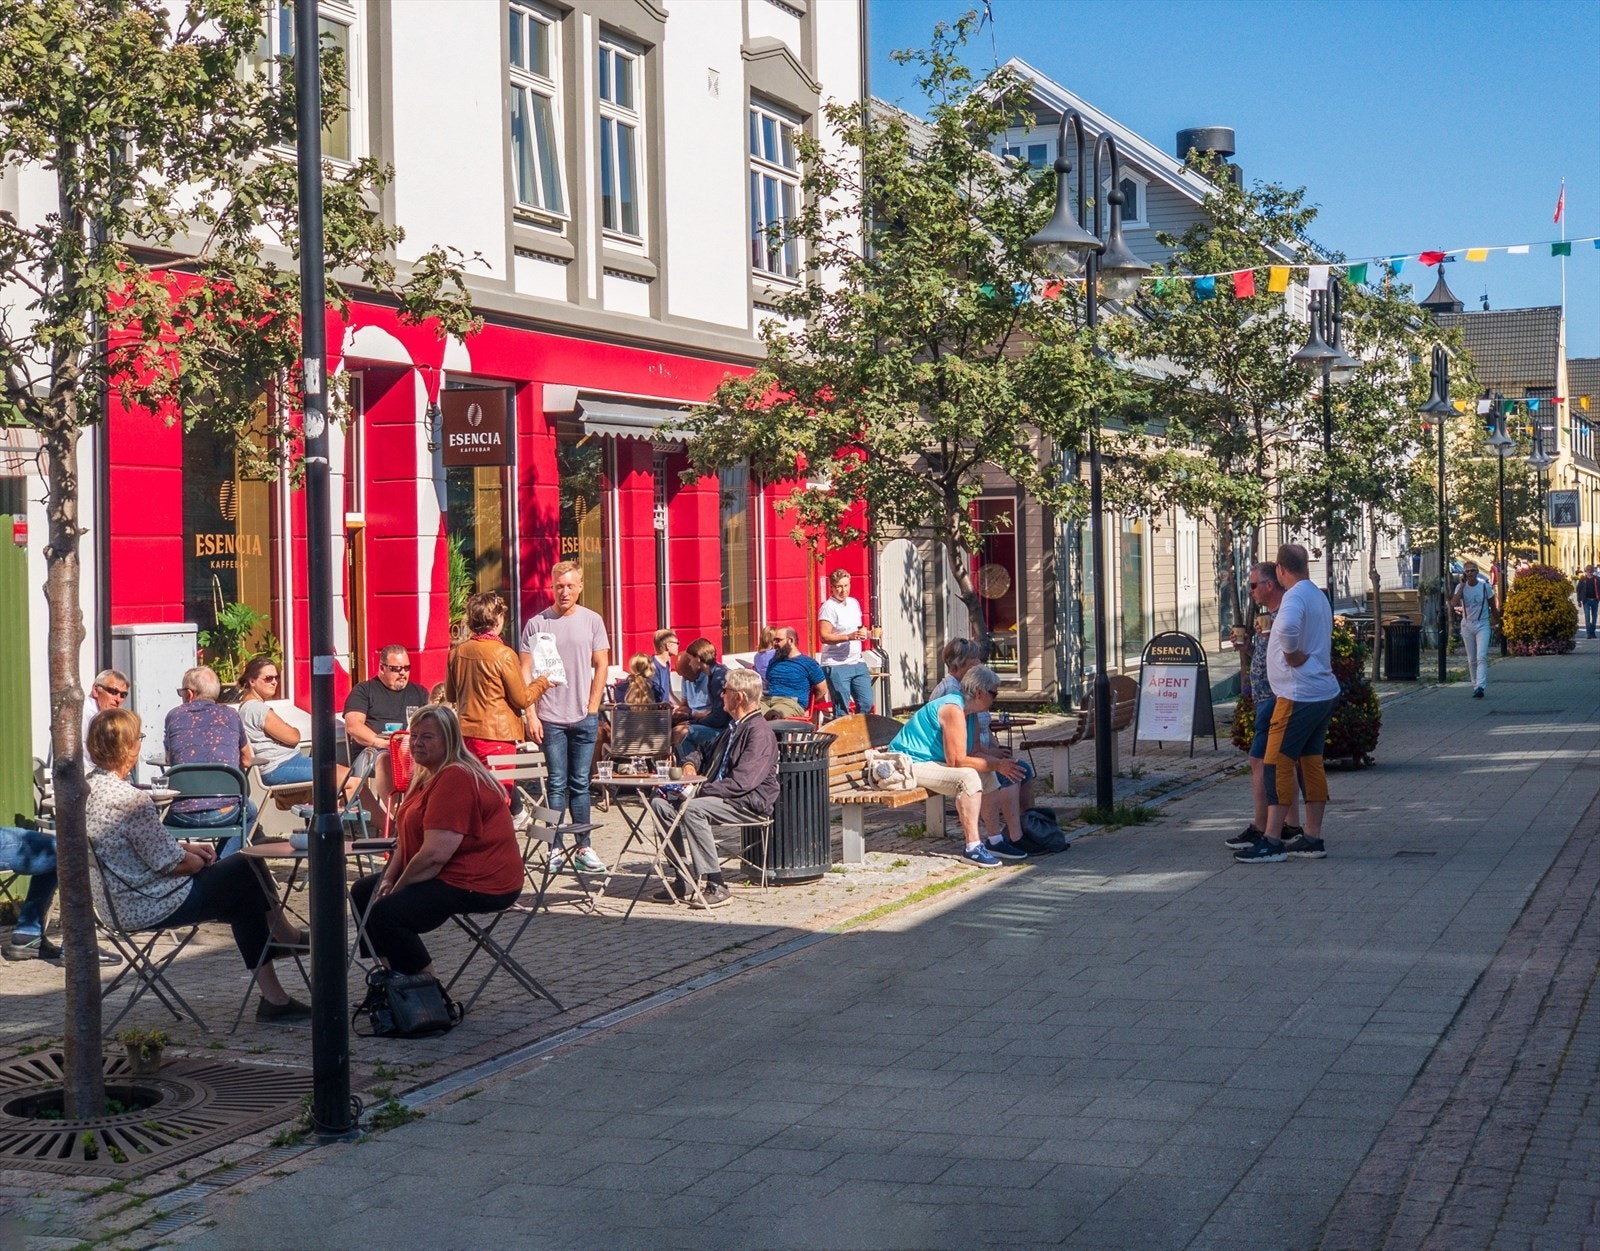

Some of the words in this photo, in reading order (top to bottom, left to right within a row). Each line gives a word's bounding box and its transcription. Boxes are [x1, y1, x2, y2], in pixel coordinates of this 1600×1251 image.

[449, 432, 502, 447] ESENCIA
[195, 533, 263, 557] ESENCIA
[561, 536, 602, 555] ESENCIA
[210, 560, 249, 569] KAFFEBAR
[1151, 646, 1191, 656] ESENCIA
[1148, 675, 1190, 688] ÅPENT
[1162, 690, 1178, 699] dag
